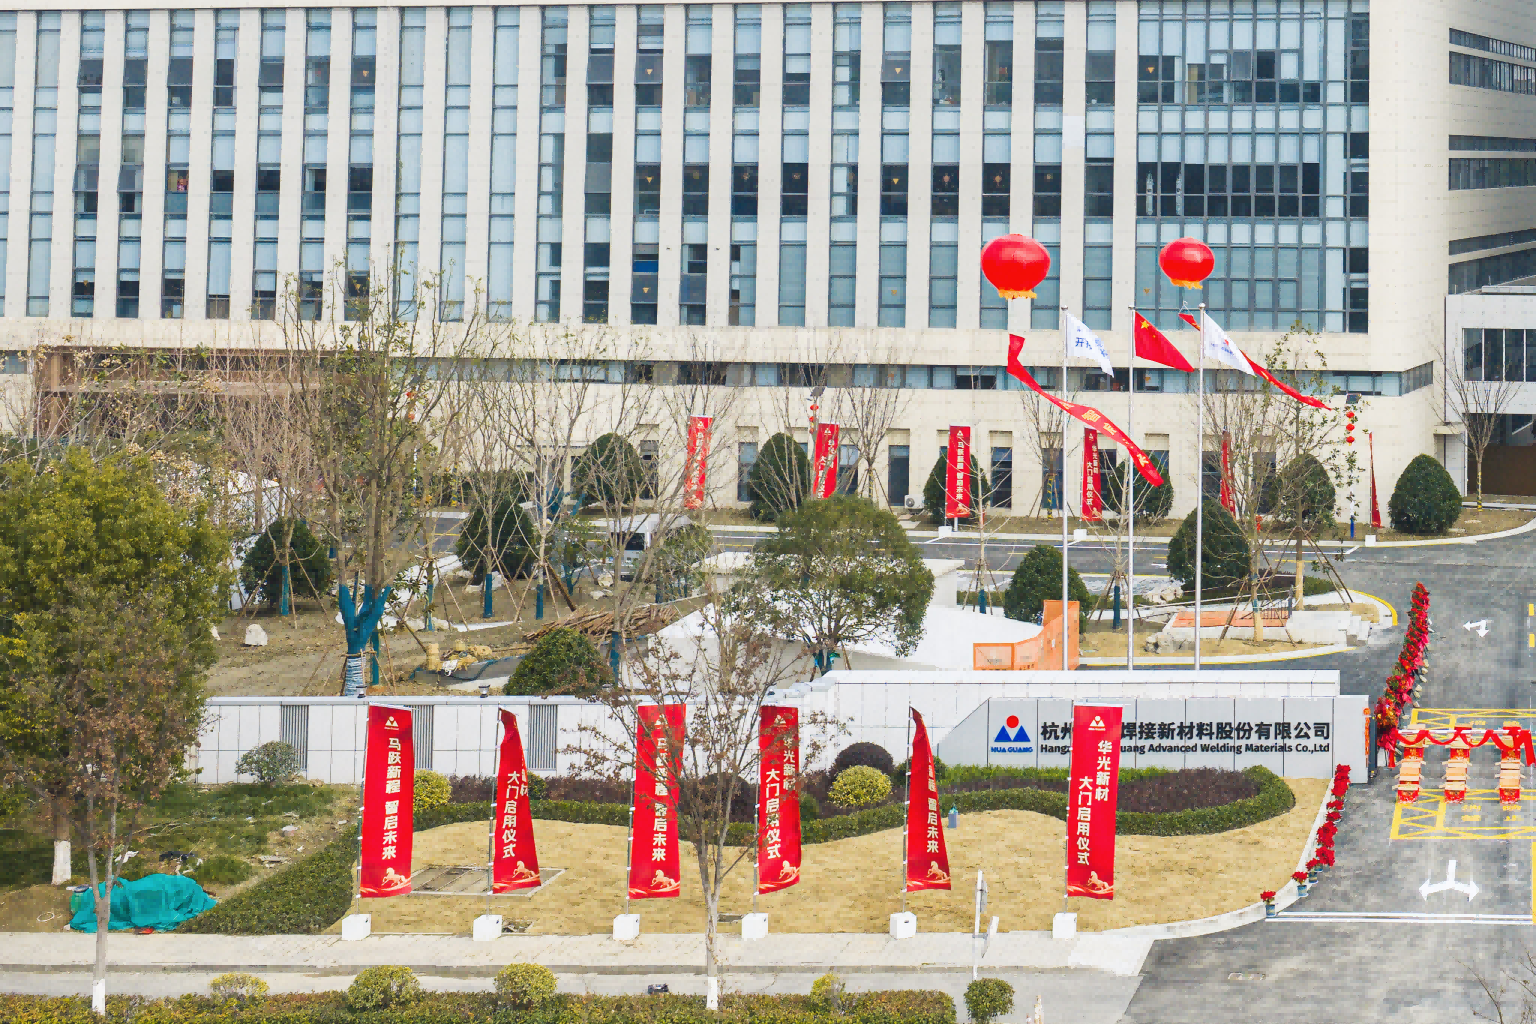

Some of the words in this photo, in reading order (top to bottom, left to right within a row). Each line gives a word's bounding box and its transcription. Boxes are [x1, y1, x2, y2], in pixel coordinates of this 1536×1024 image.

[385, 737, 402, 795] 马跃新程
[1095, 739, 1113, 802] 华光新材
[1147, 743, 1198, 754] Advanced
[1200, 743, 1243, 755] Welding
[1245, 743, 1293, 754] Materials
[381, 799, 400, 861] 智启未来
[502, 770, 521, 859] 大门启用仪式
[1076, 775, 1094, 866] 大门启用仪式
